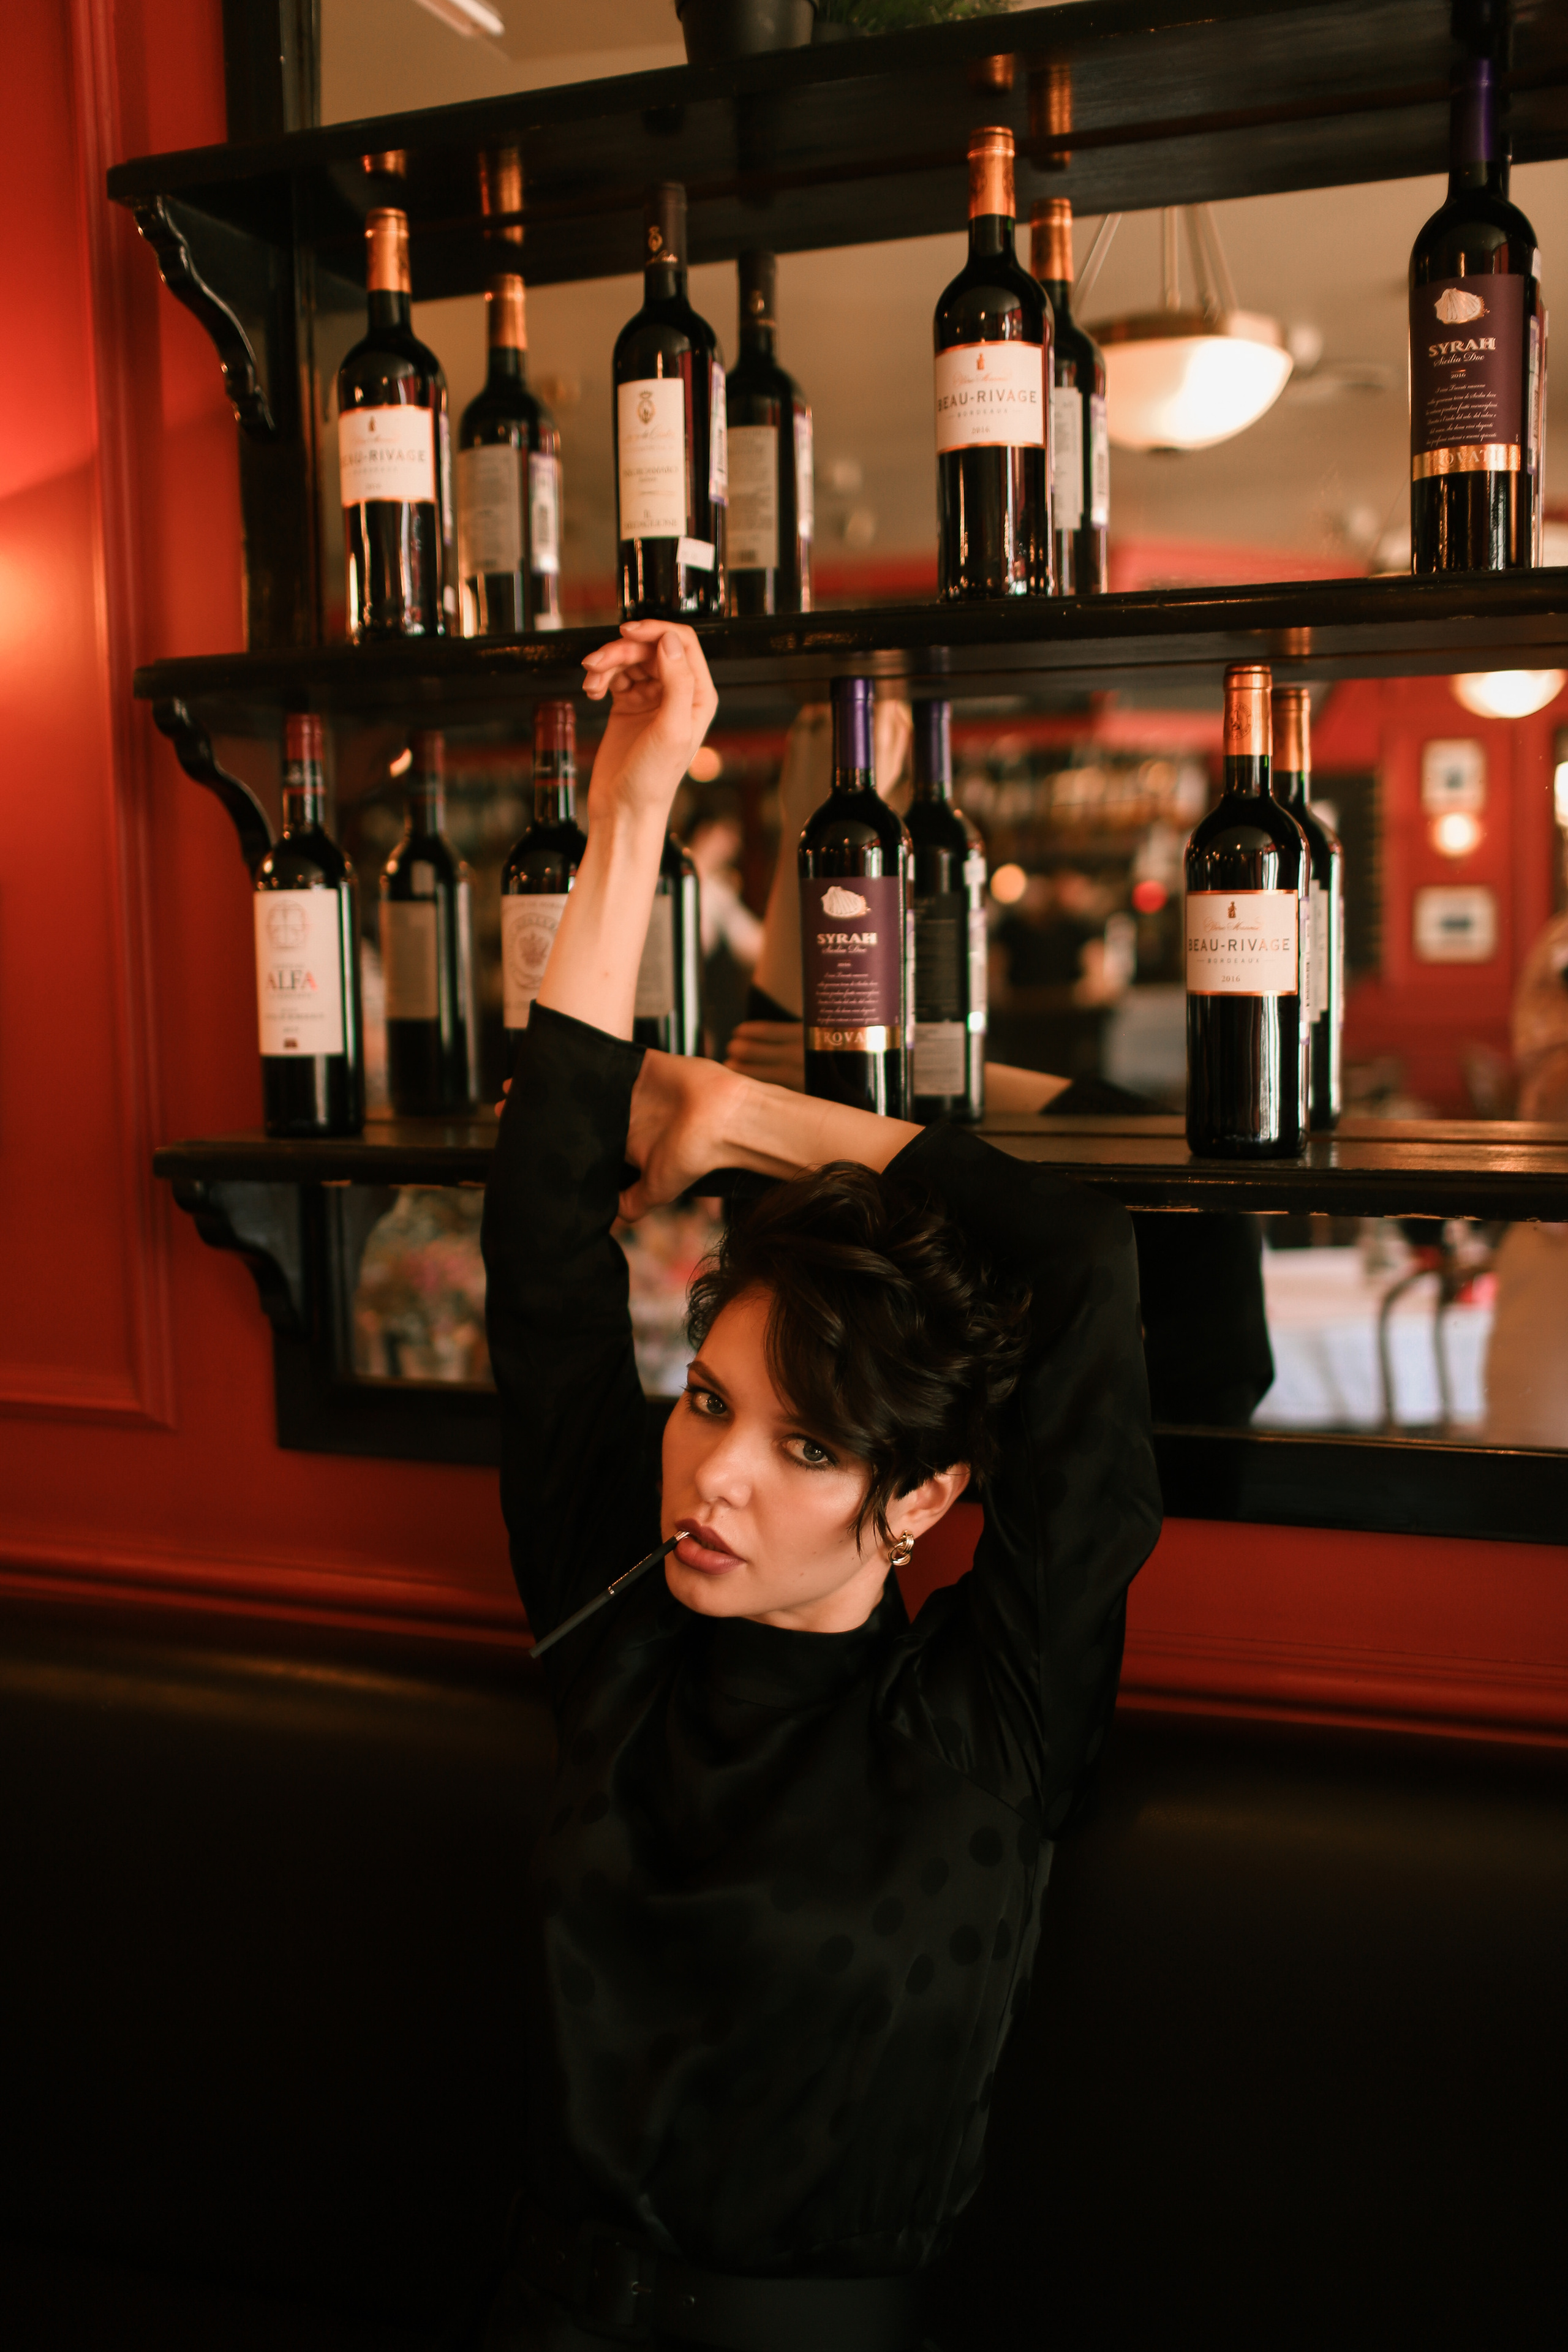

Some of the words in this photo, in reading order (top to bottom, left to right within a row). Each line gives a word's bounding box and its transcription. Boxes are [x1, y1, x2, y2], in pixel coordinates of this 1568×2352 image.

[1428, 337, 1496, 358] SYRAH
[1433, 353, 1462, 367] Sicilia
[1463, 352, 1485, 361] Doc
[938, 389, 1037, 412] BEAU-RIVAGE
[817, 933, 877, 944] SYRAH
[1188, 938, 1290, 951] BEAU-RIVAGE
[266, 970, 318, 990] ALFA
